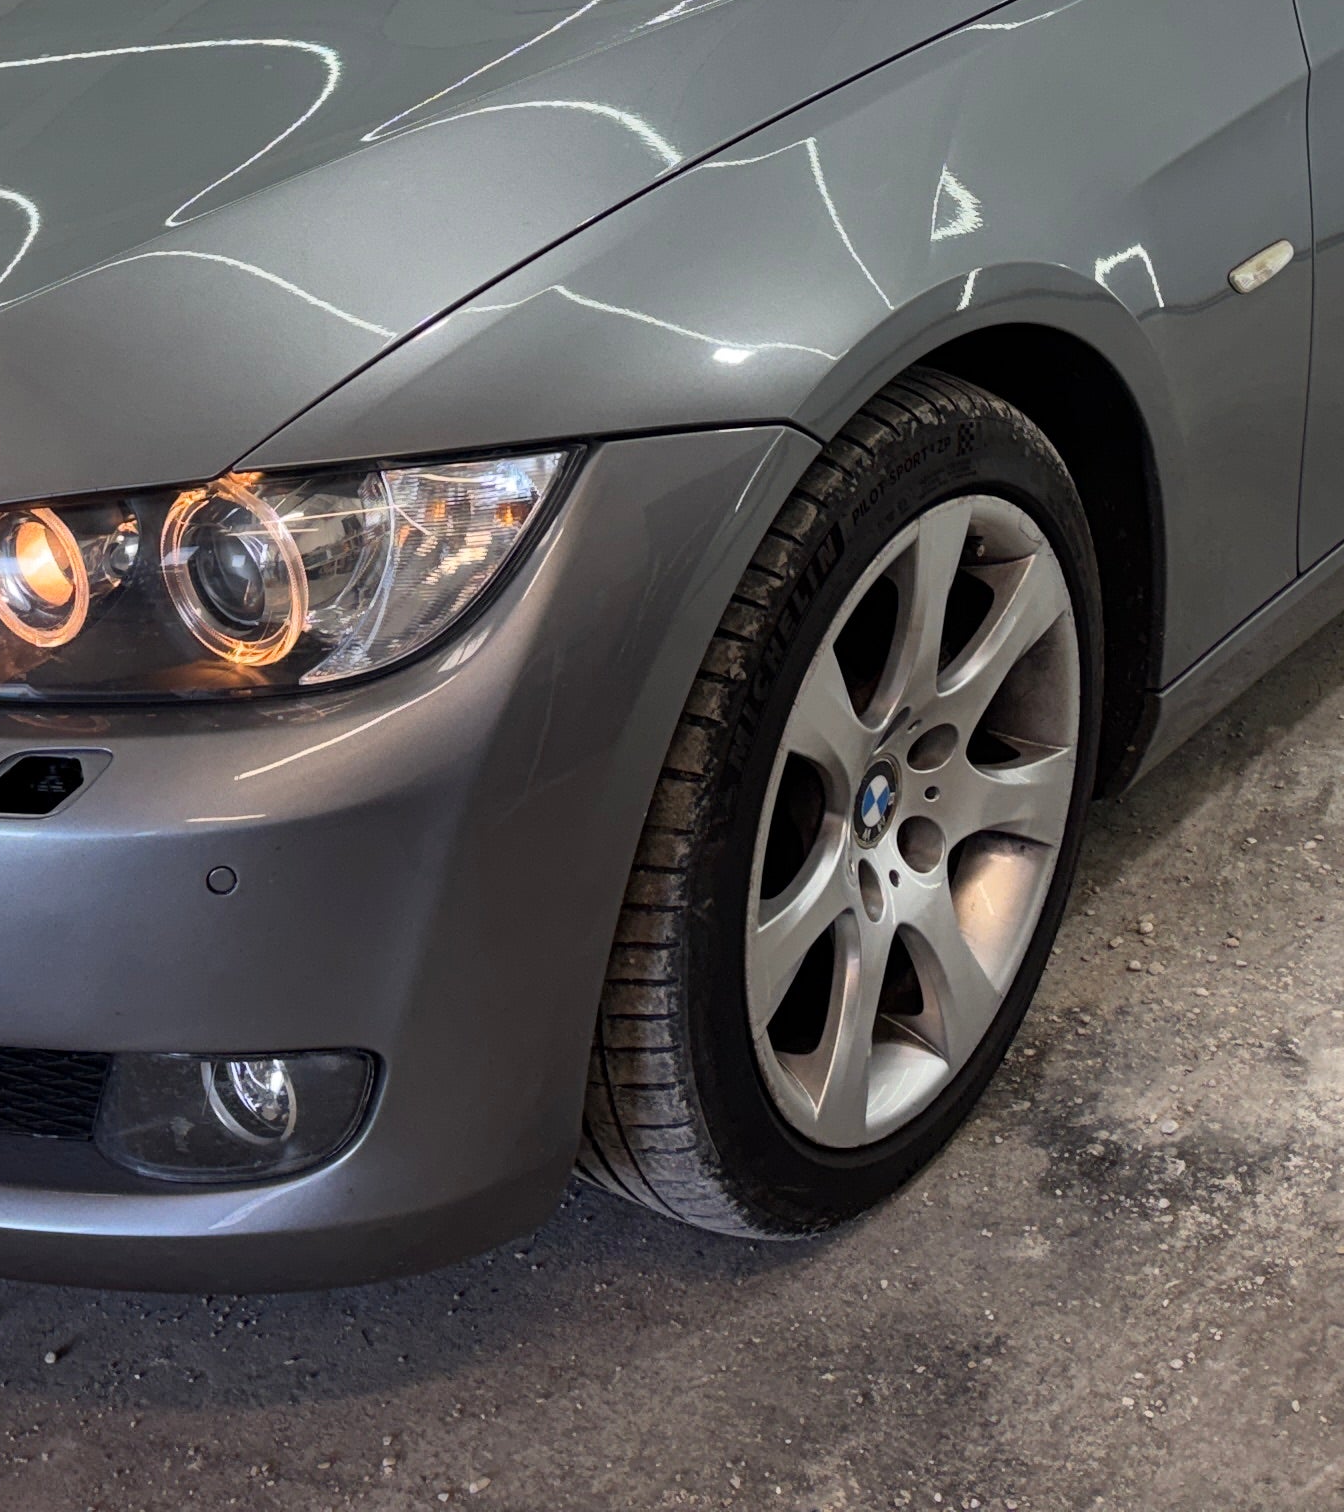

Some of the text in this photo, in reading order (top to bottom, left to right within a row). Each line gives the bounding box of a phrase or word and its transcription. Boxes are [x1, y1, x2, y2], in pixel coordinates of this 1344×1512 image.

[851, 480, 887, 526] PILOT
[889, 446, 929, 486] SPORT
[726, 526, 843, 768] MICHELIN
